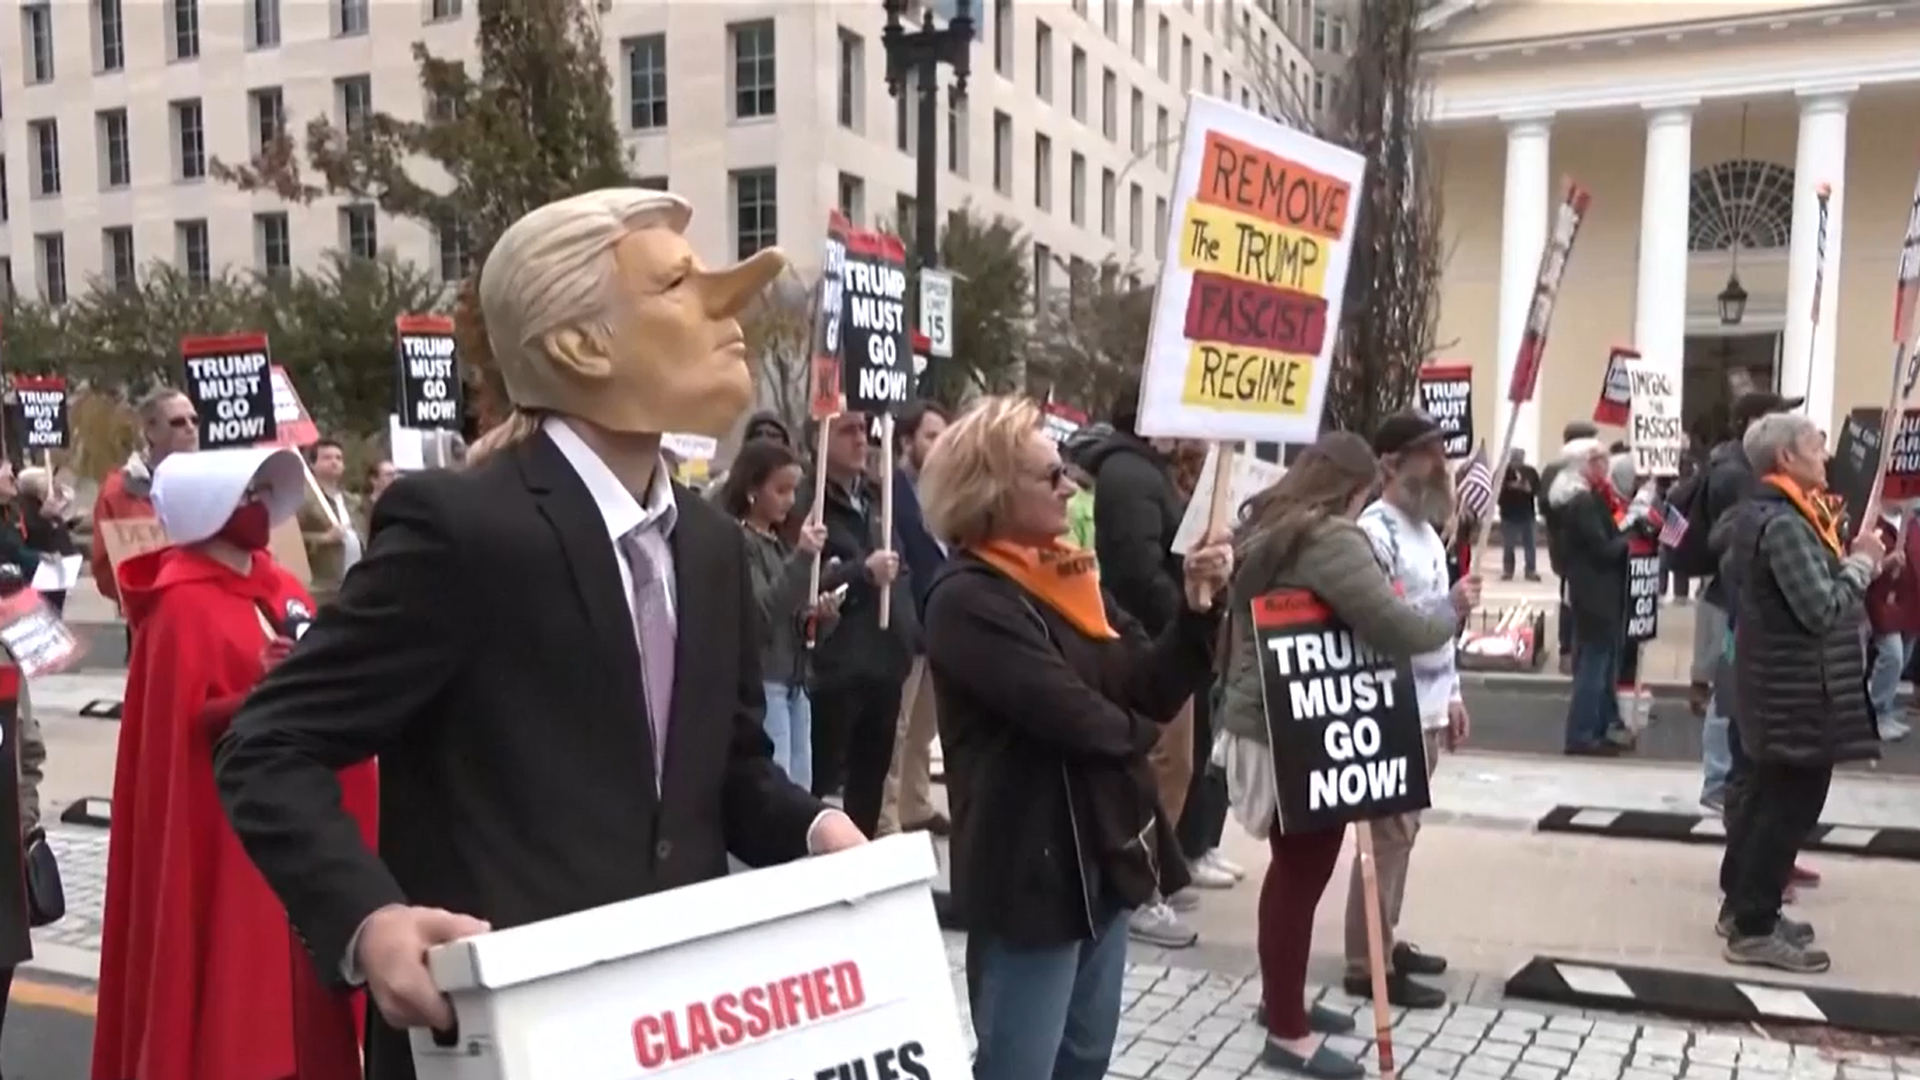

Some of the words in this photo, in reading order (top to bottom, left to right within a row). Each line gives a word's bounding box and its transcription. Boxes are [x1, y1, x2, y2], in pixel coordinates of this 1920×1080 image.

[1214, 142, 1346, 232] REMOVE
[1190, 219, 1220, 262] The
[1235, 222, 1319, 287] TRUMP
[844, 261, 906, 299] TRUMP
[851, 297, 904, 333] MUST
[1200, 287, 1316, 343] FASCIST
[928, 315, 946, 344] 15
[402, 337, 455, 356] TRUMP
[868, 334, 897, 366] GO
[187, 352, 266, 379] TRUMP
[410, 358, 452, 378] MUST
[1200, 346, 1300, 406] REGIME
[18, 390, 64, 404] TRUMP
[198, 375, 261, 400] MUST
[423, 379, 447, 399] GO
[859, 367, 907, 402] NOW!
[1421, 381, 1470, 400] TRUMP
[24, 404, 60, 418] MUST
[216, 398, 250, 420] GO
[417, 400, 456, 421] NOW!
[1428, 400, 1466, 417] MUST
[34, 418, 53, 431] GO
[208, 417, 265, 442] NOW!
[1634, 413, 1681, 440] FASCIST
[1636, 597, 1653, 615] GO
[1267, 629, 1395, 675] TRU
[1289, 669, 1397, 720] MUST
[1324, 716, 1381, 761] GO
[1309, 756, 1408, 811] NOW!
[631, 959, 866, 1070] CLASSIFIED
